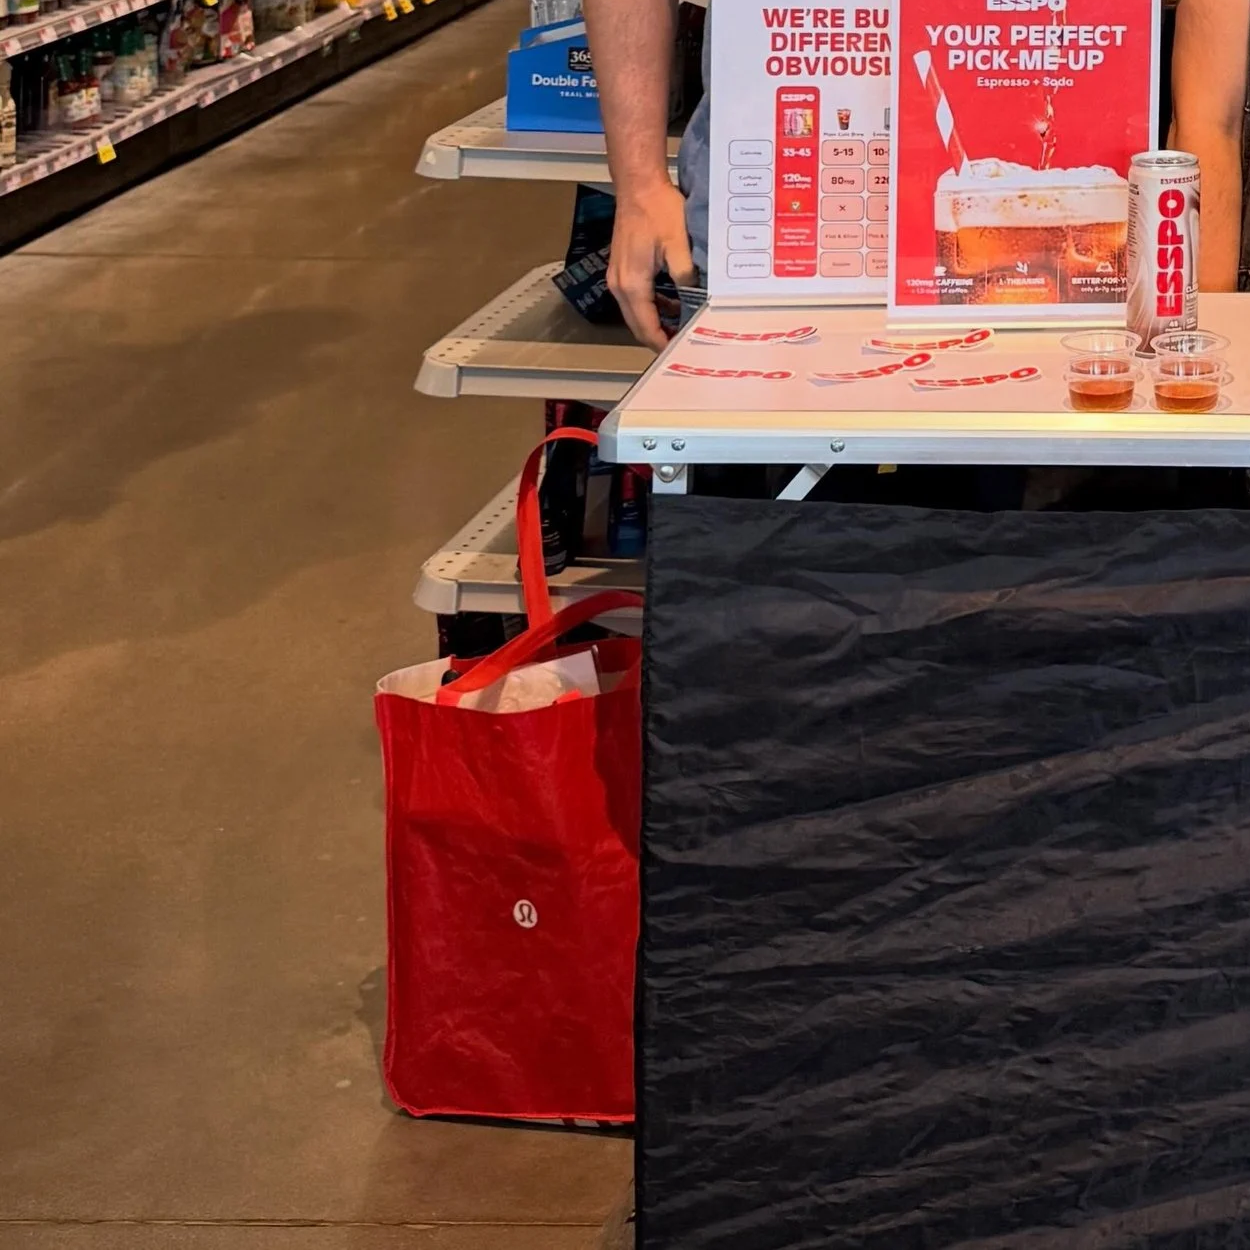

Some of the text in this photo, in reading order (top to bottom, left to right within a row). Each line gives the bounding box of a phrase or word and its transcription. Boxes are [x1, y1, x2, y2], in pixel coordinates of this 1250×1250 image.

[762, 8, 889, 28] WE'RE BU
[771, 32, 891, 52] DIFFEREN
[925, 24, 1128, 47] YOUR PERFECT
[948, 49, 1105, 71] PICK-ME-UP
[531, 73, 579, 86] Double
[976, 76, 1074, 89] Espresso Soda
[833, 148, 854, 156] 5-15
[831, 176, 855, 185] 80mg
[1156, 188, 1185, 317] ESSPO
[906, 279, 934, 287] 120mg
[935, 278, 974, 286] CAFFEINE
[669, 363, 793, 379] ESSPO
[914, 367, 1038, 387] ESSPO
